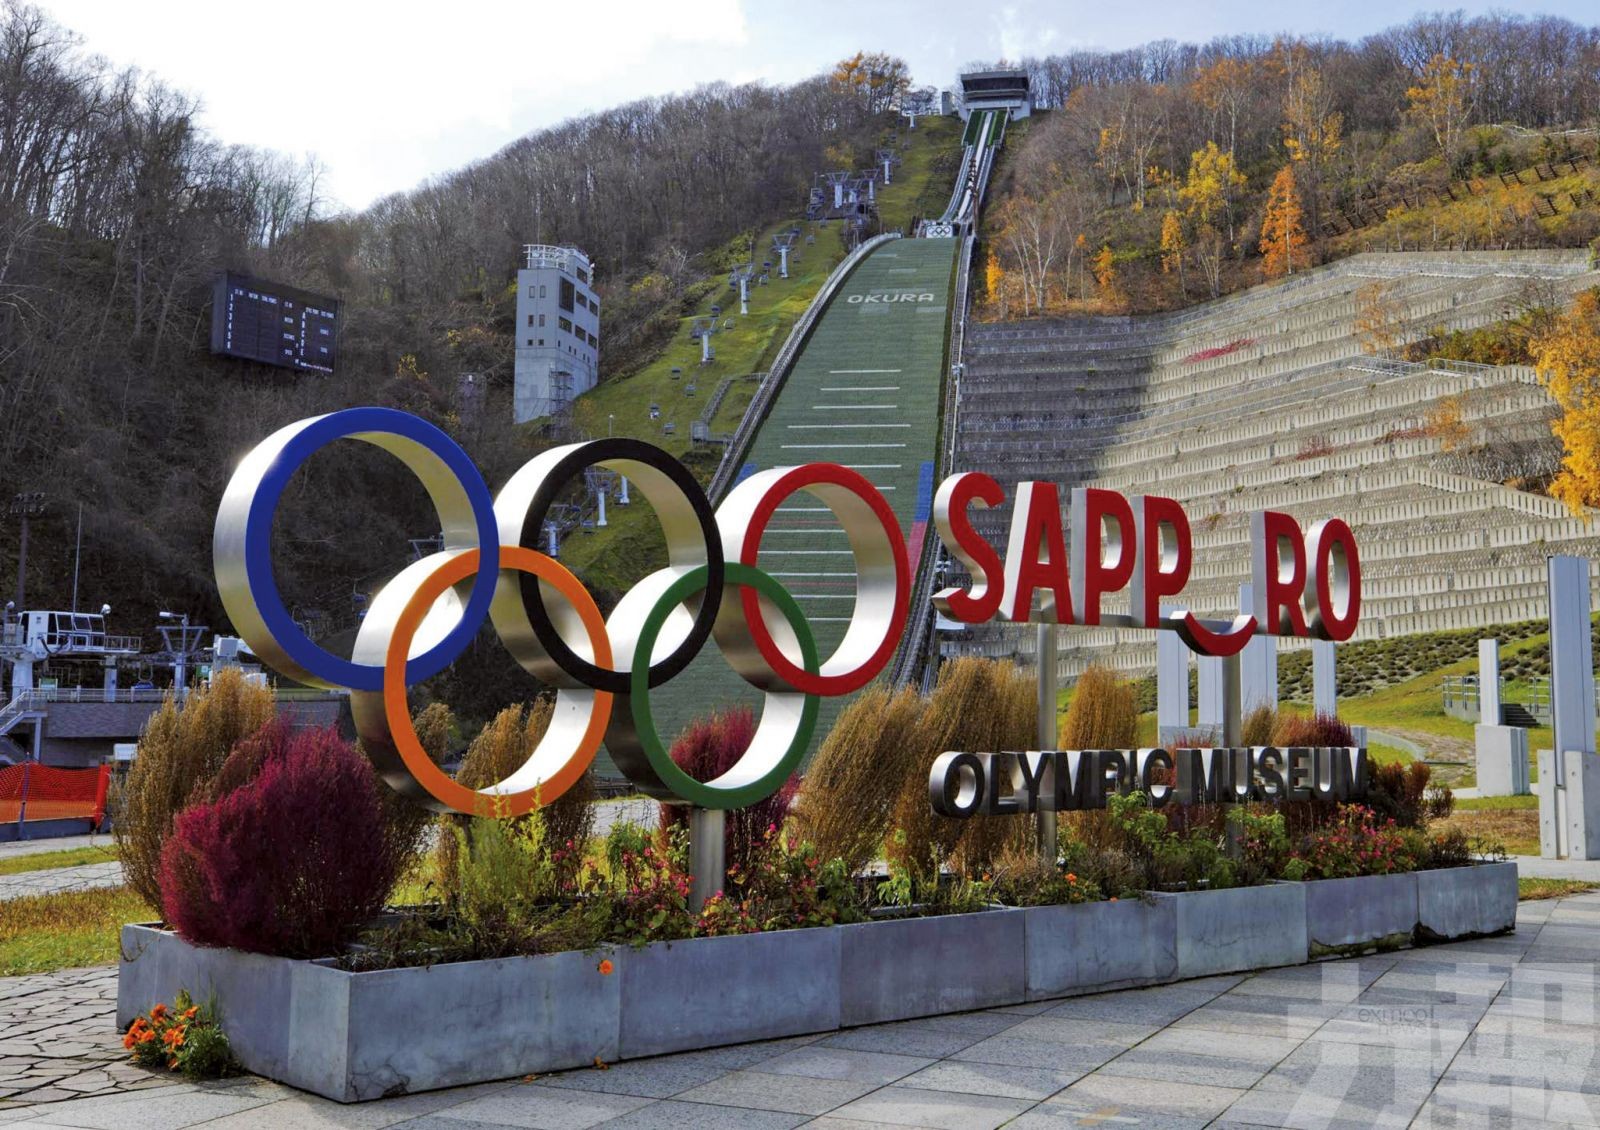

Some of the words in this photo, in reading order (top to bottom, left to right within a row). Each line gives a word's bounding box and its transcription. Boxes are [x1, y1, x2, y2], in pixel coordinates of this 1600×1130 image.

[847, 293, 935, 304] OKURA
[929, 749, 1175, 818] OLYMPIC
[1177, 747, 1367, 803] MUSEUM
